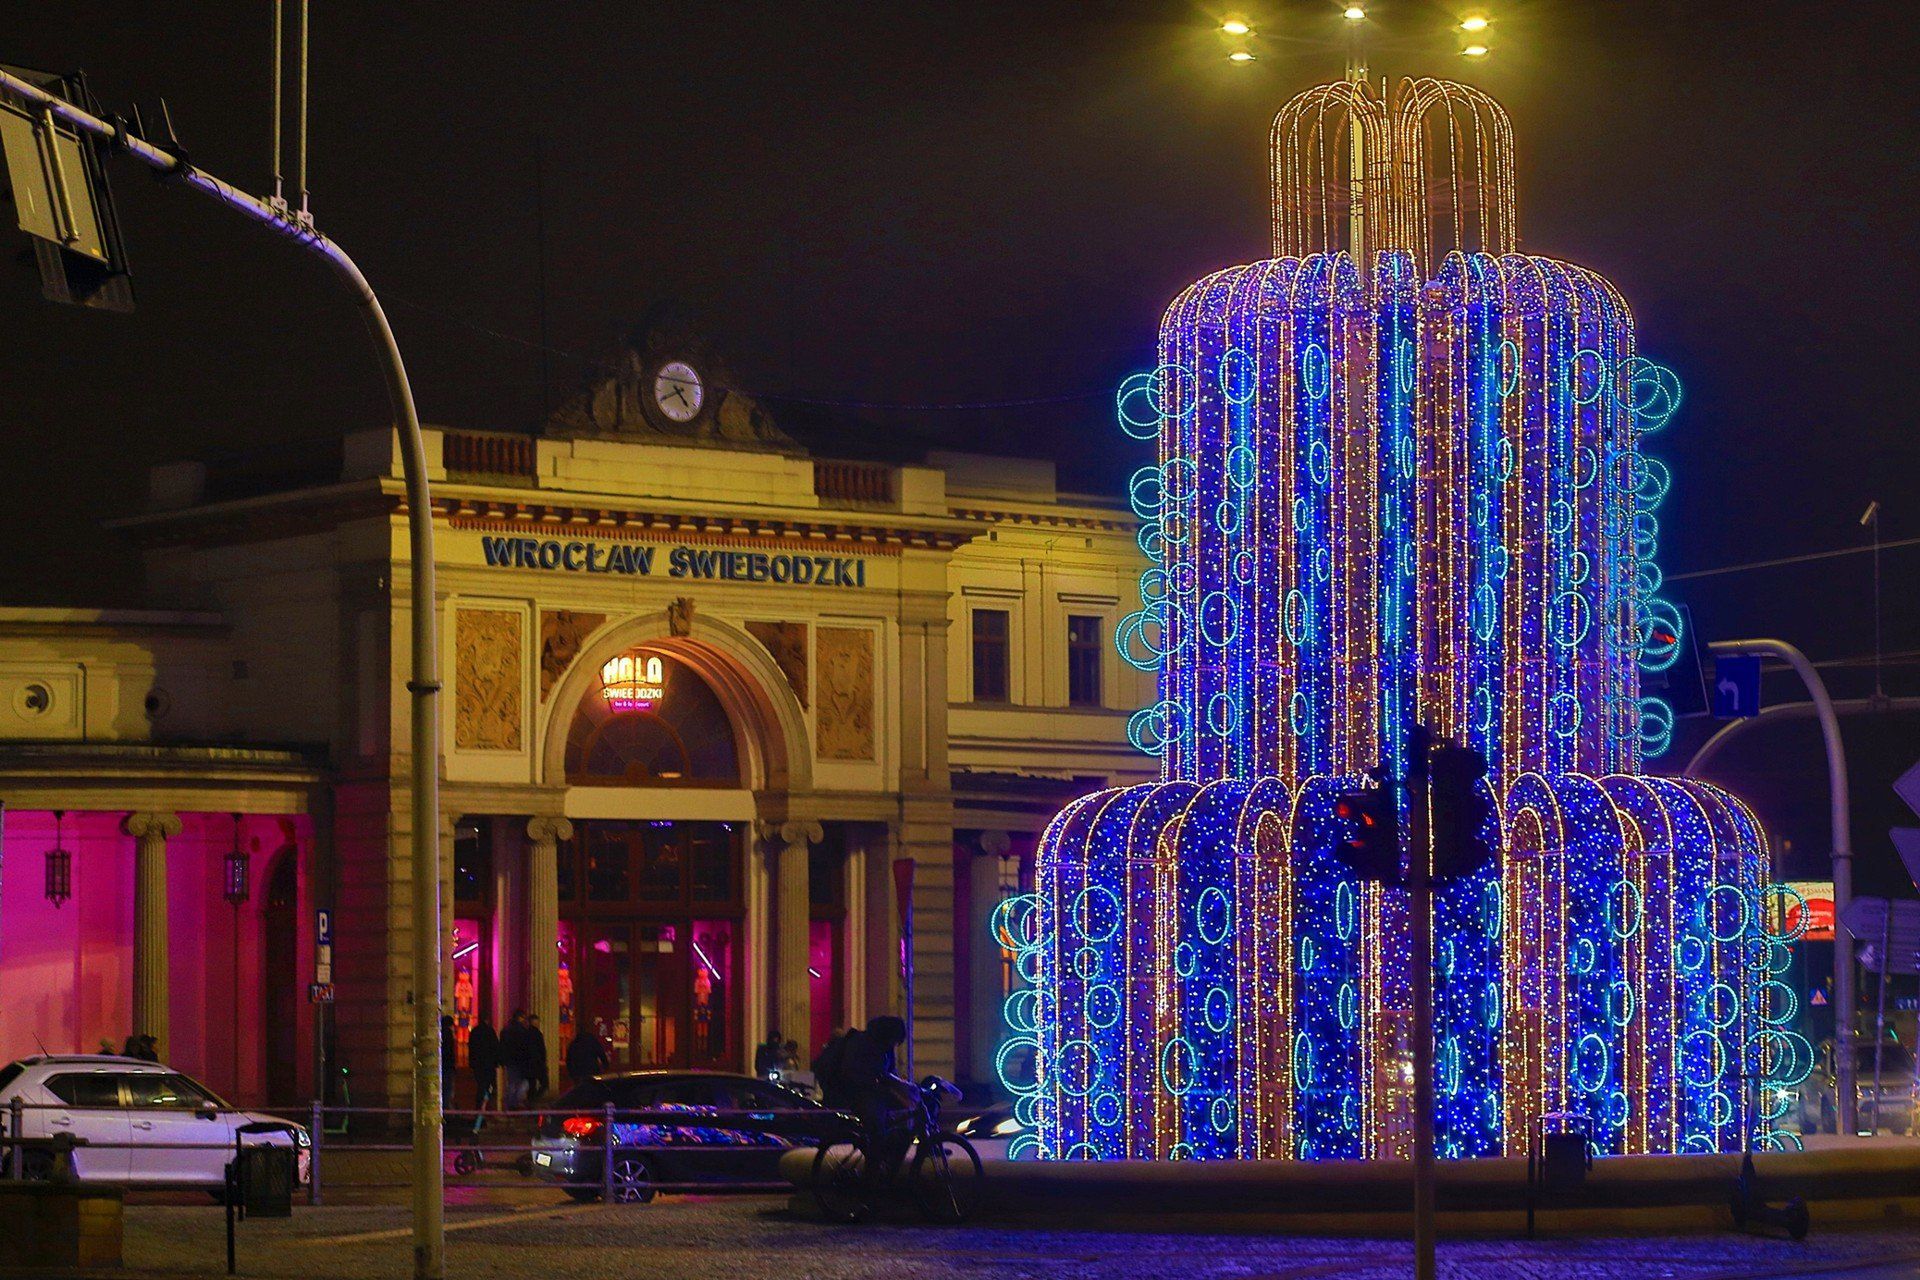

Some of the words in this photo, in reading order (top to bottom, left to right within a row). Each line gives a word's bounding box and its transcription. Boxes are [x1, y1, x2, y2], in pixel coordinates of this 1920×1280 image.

[482, 536, 656, 576] WROCŁAW
[668, 545, 866, 587] ŚWIEBODZKI
[319, 912, 328, 941] P
